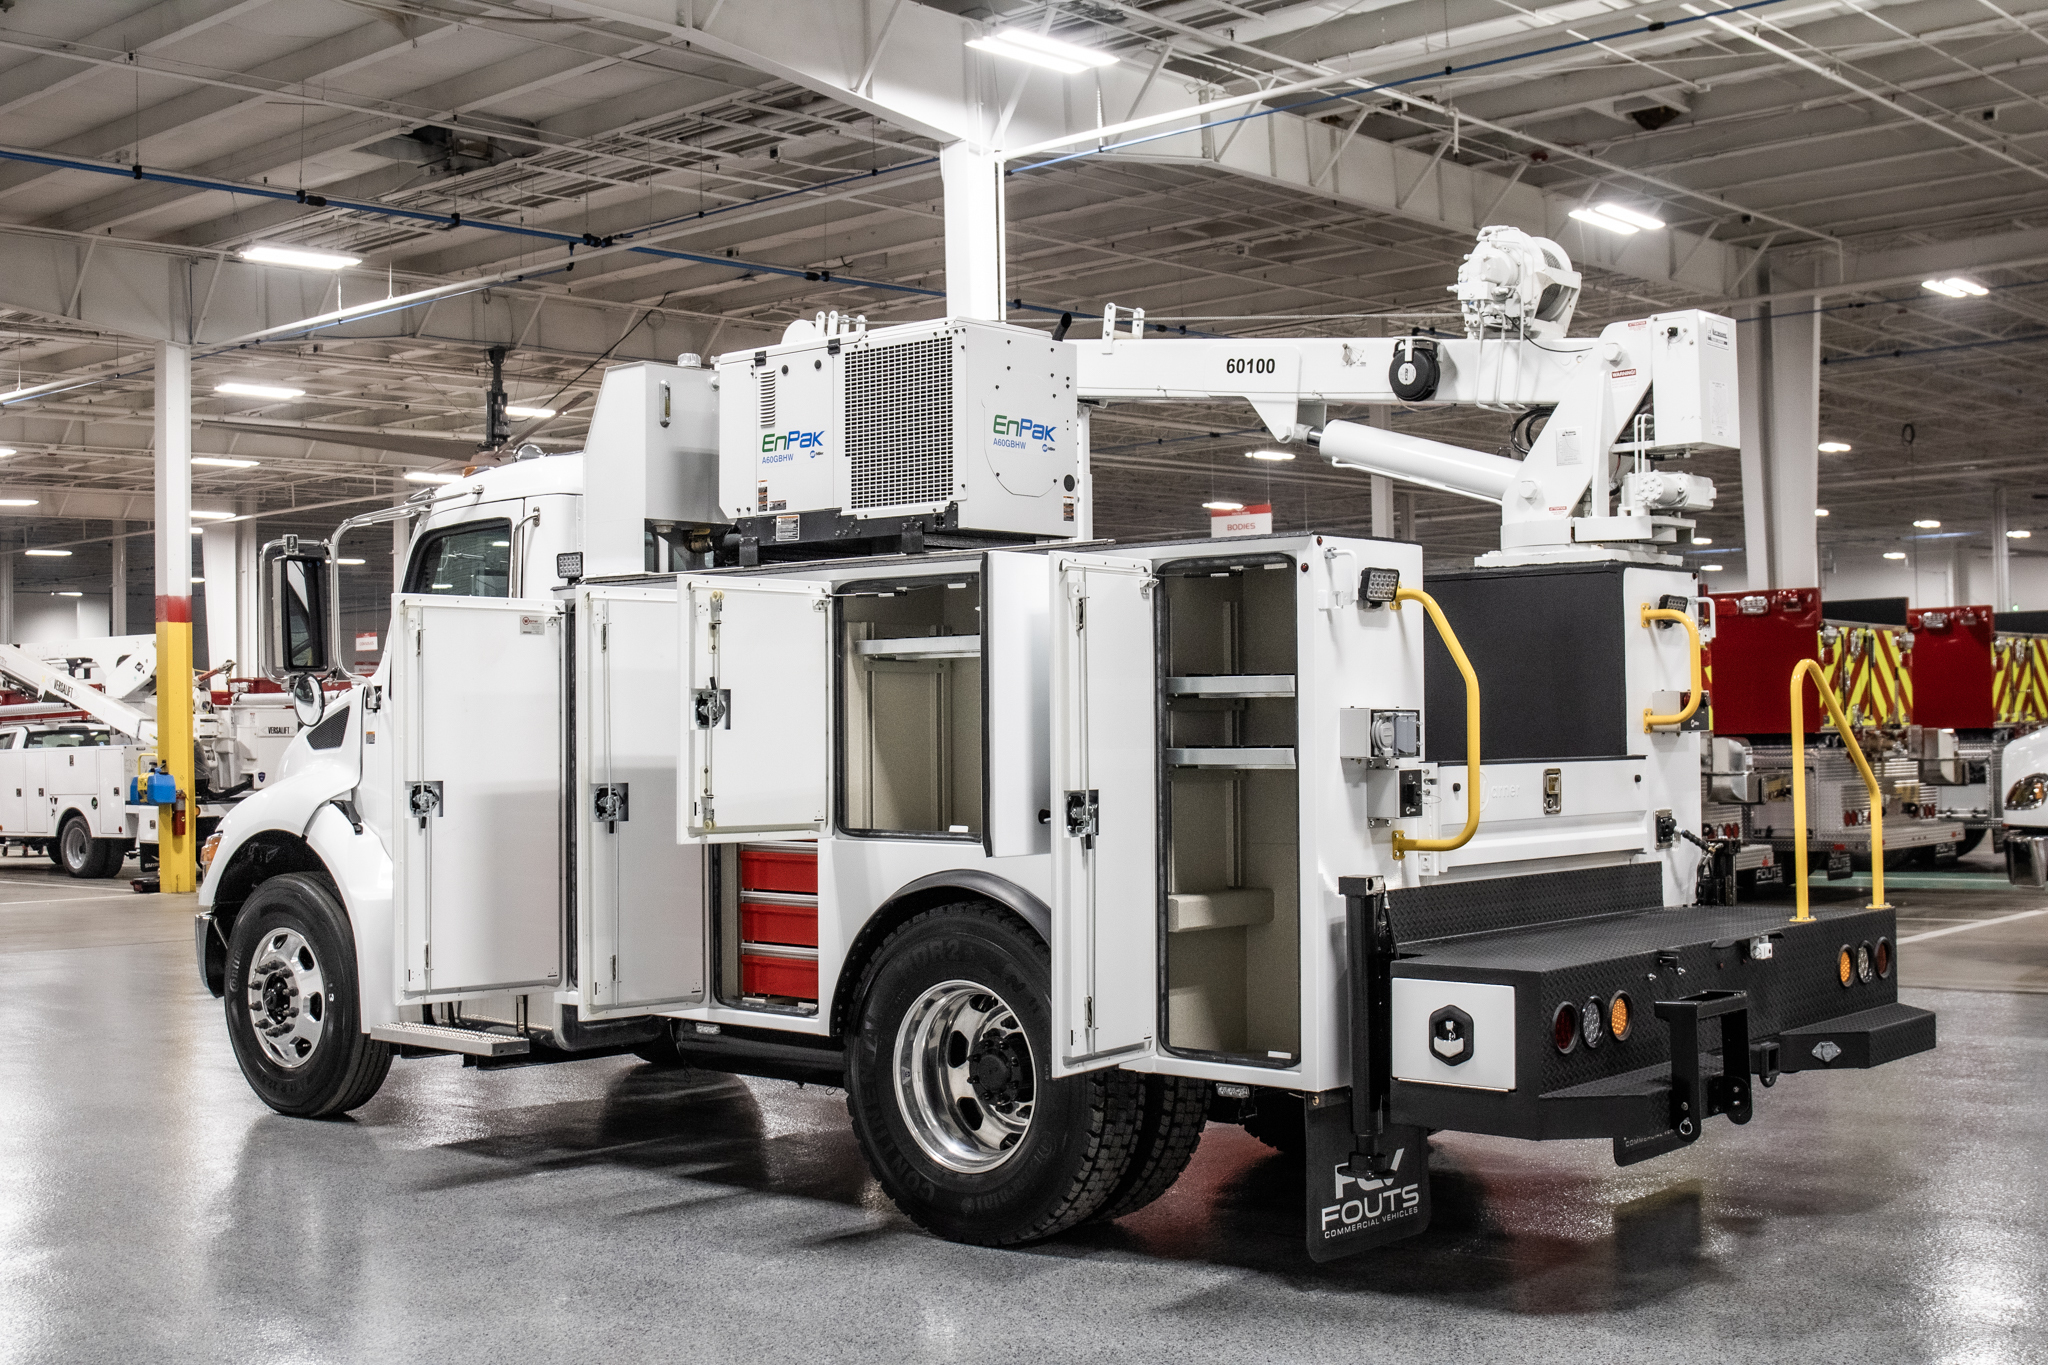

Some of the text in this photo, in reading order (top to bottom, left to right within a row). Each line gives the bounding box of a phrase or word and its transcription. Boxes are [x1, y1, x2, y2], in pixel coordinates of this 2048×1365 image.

[1226, 358, 1275, 373] 60100
[993, 414, 1057, 442] EnPak
[762, 430, 825, 453] EnPak
[993, 438, 1026, 449] A60GBHW
[762, 454, 794, 464] A60GBHW
[1227, 523, 1256, 531] BODIES
[54, 679, 73, 698] VERSALIFT
[1756, 866, 1782, 880] FOUTS
[1322, 1184, 1420, 1232] FOUTS
[1324, 1207, 1418, 1239] COMMERCIAL VEHICLES
